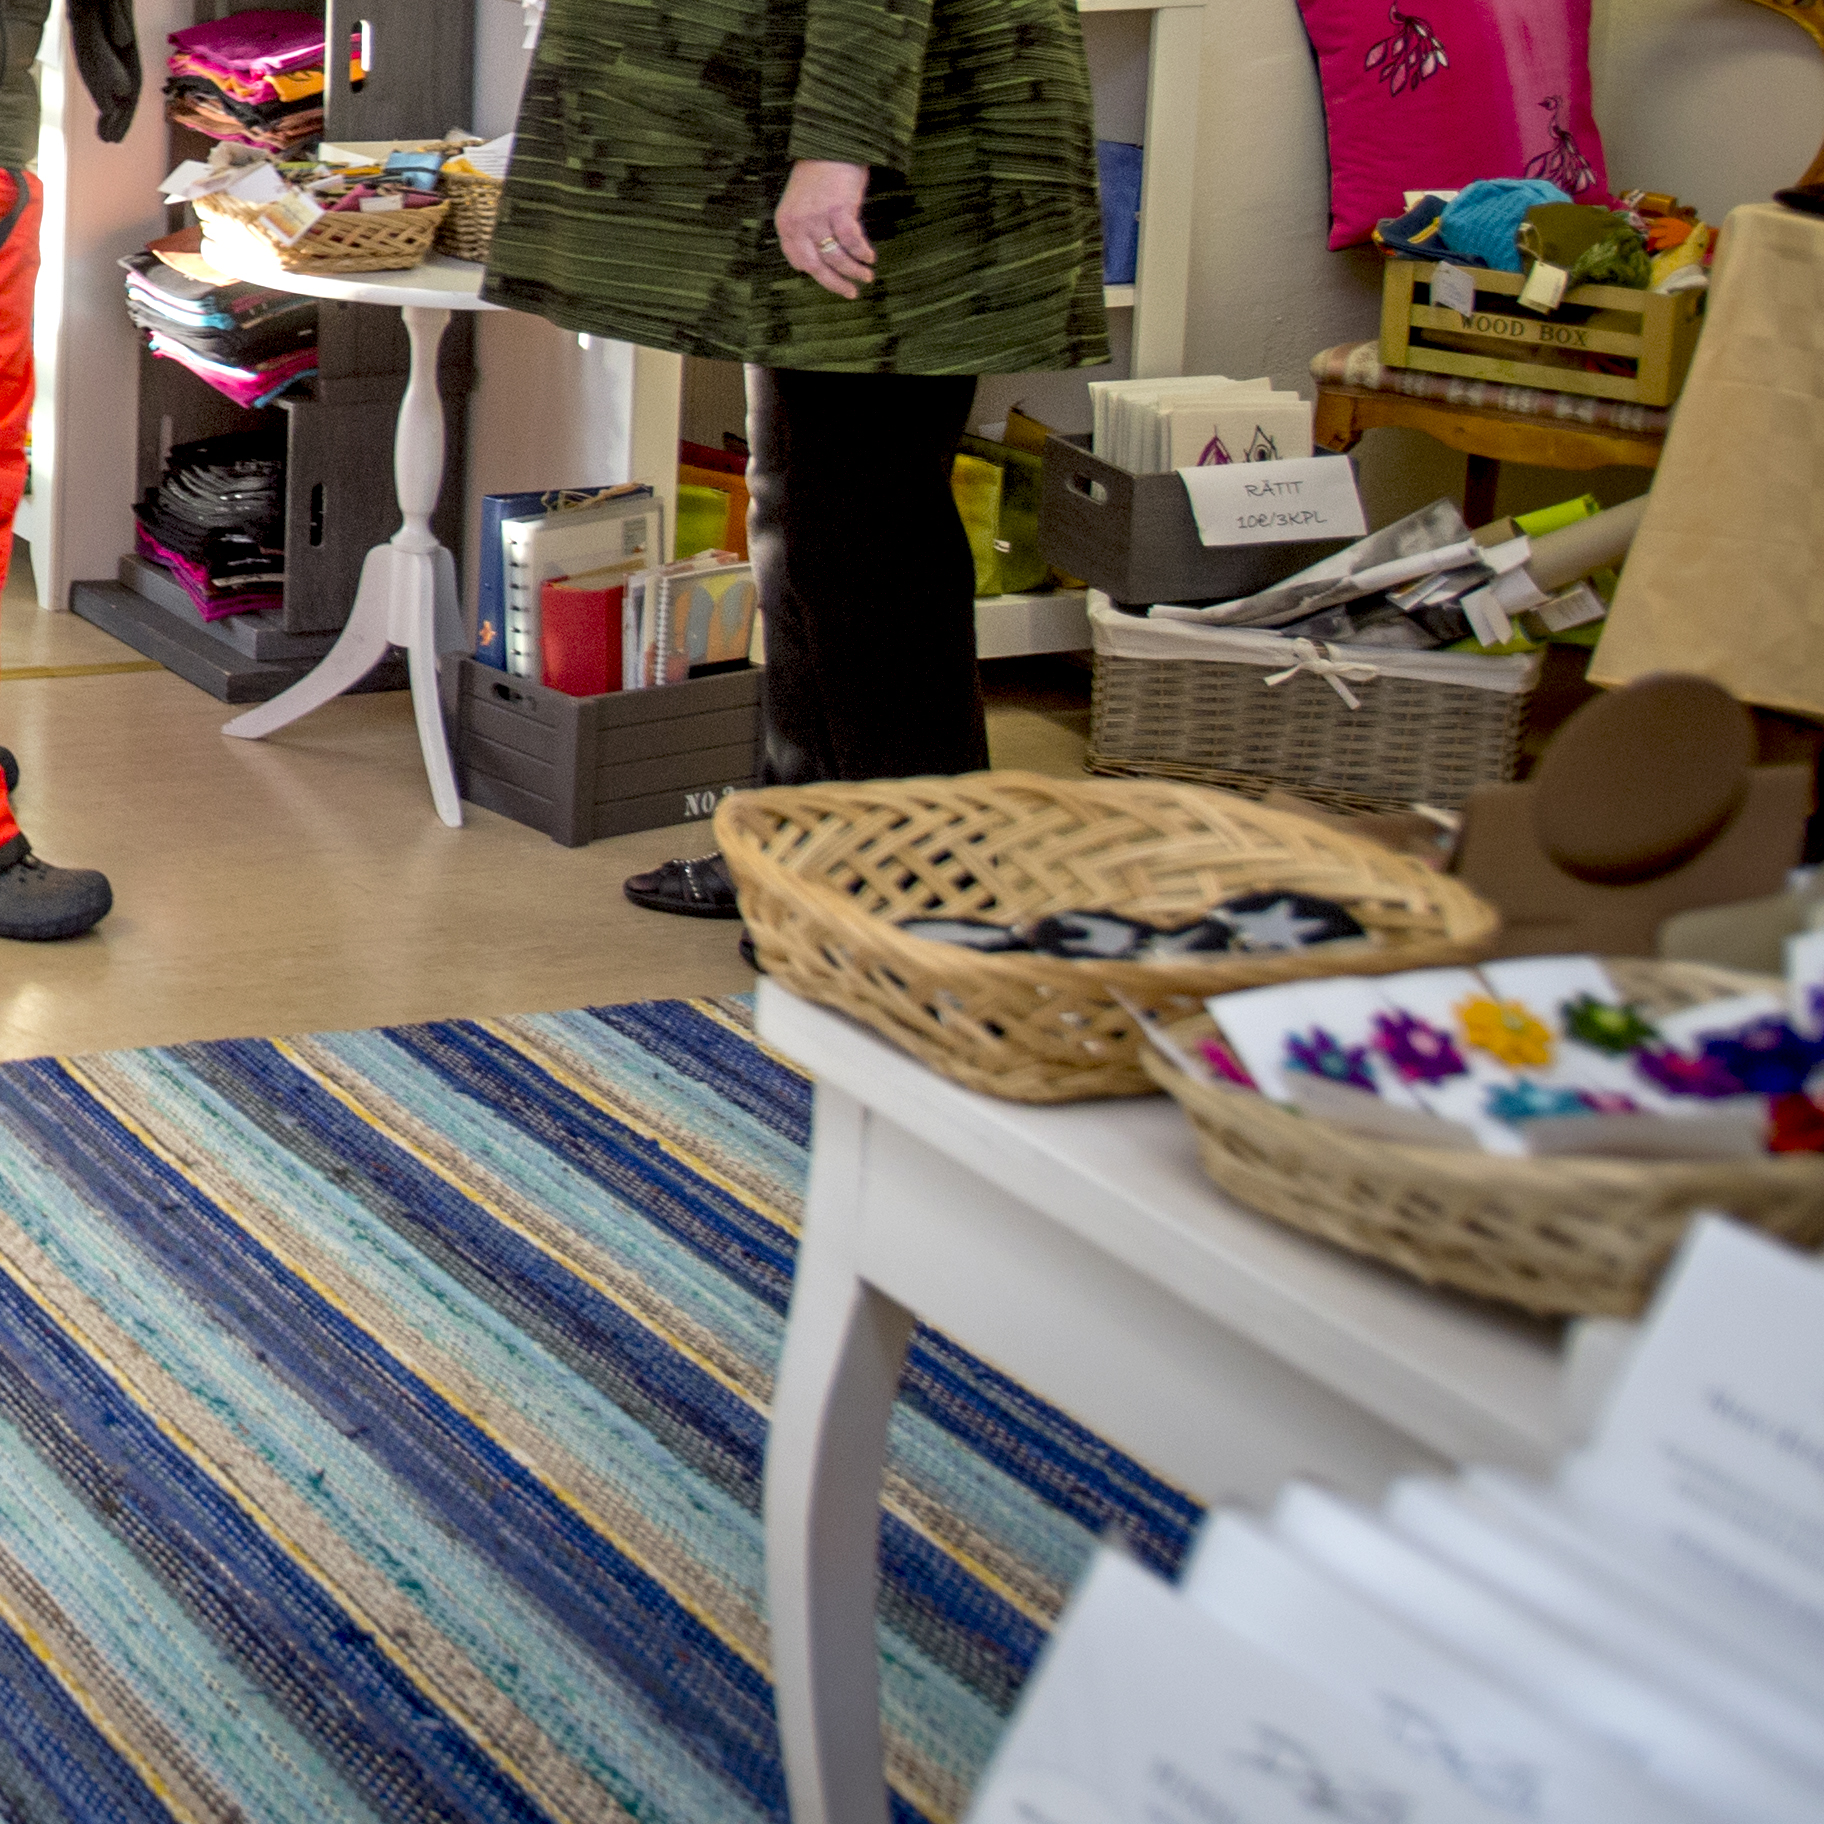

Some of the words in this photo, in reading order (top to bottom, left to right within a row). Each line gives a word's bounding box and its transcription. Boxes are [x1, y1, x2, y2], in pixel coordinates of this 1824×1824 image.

[1460, 314, 1525, 337] WOOD
[1539, 324, 1588, 347] BOX
[1245, 480, 1303, 497] RÄTIT
